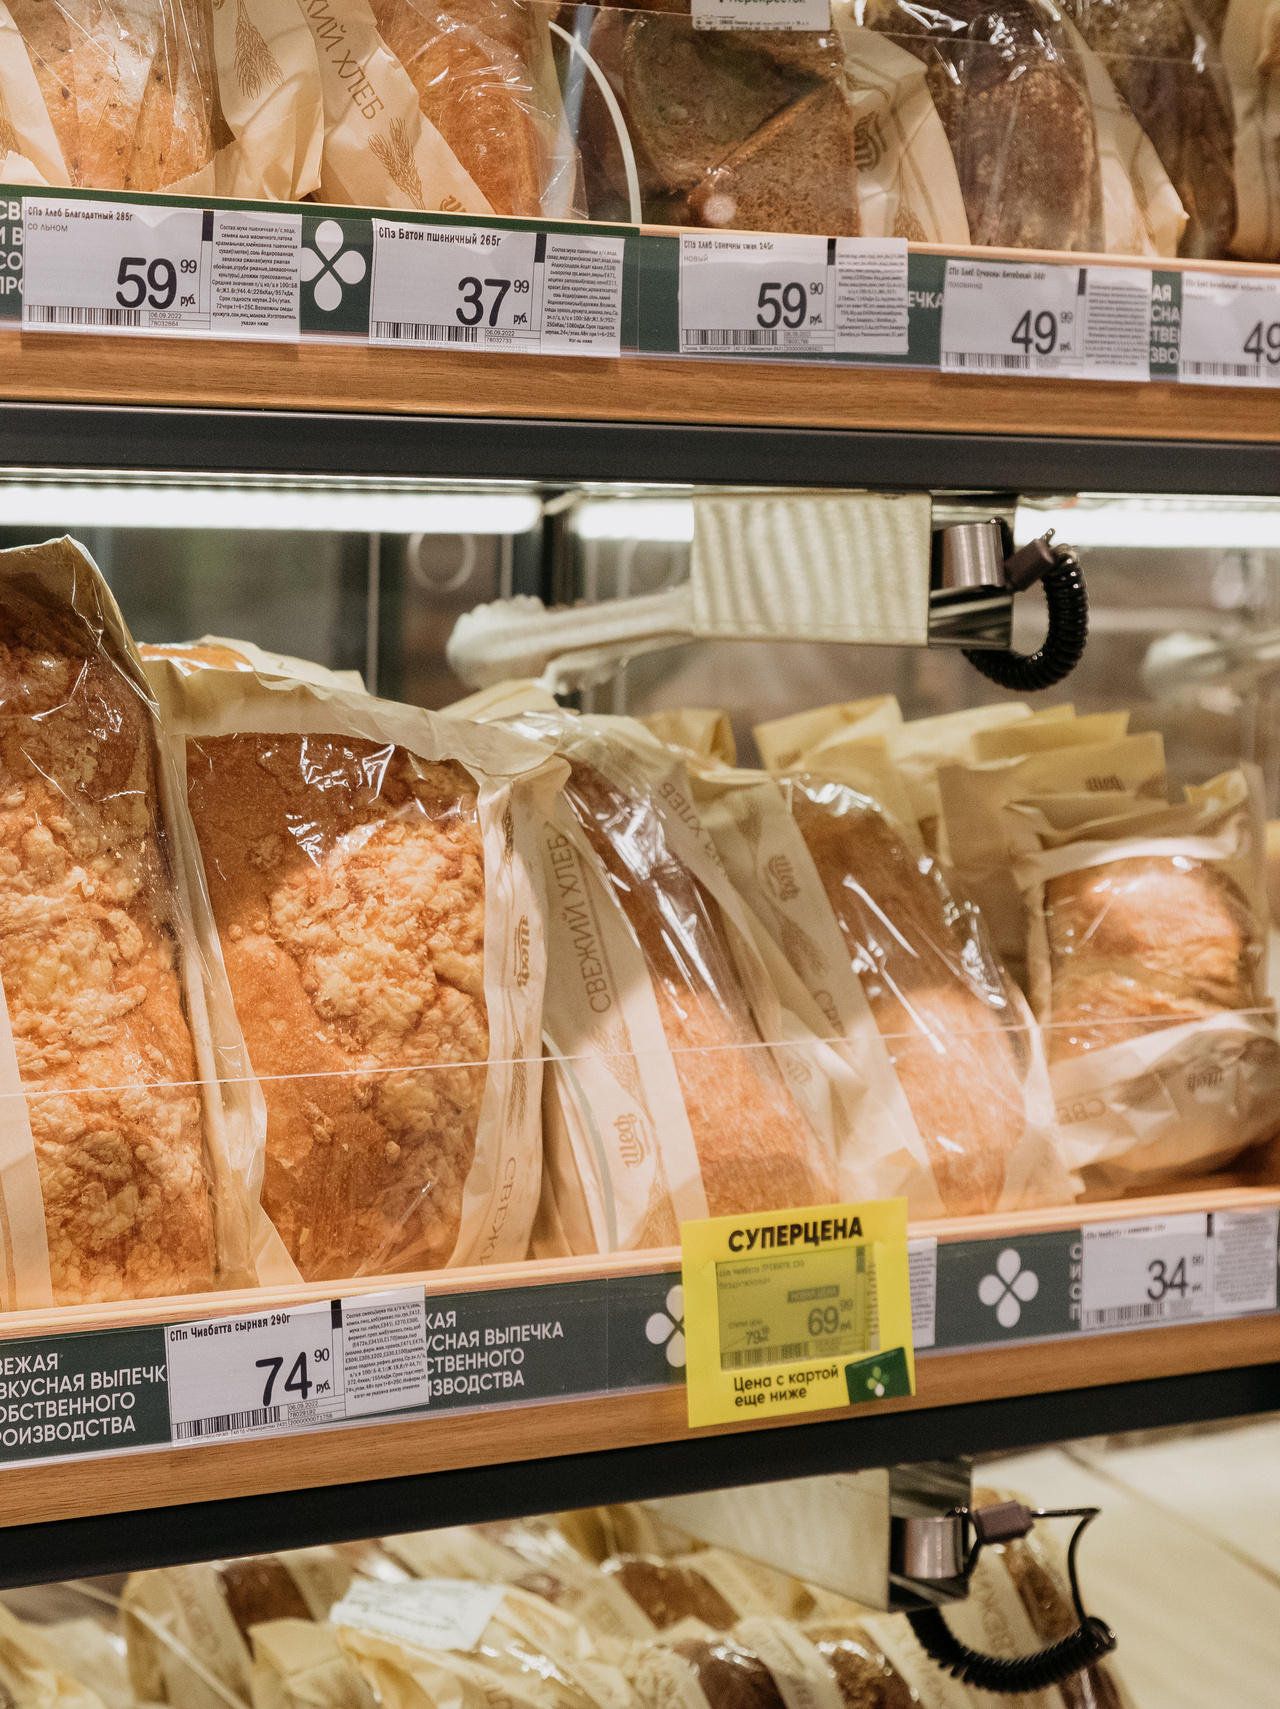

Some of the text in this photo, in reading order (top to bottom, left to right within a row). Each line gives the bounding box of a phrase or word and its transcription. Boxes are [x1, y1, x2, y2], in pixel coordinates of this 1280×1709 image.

[332, 50, 385, 119] ХЛЕБ
[41, 223, 68, 232] льном
[45, 208, 62, 217] Хлеб
[65, 208, 114, 220] Благодатный
[116, 211, 133, 221] 285г
[379, 227, 501, 246] СПз Батон пшеничный 265г
[684, 253, 708, 262] новый
[115, 257, 177, 310] 59
[180, 259, 197, 274] 99
[180, 294, 196, 307] руб.
[456, 276, 530, 328] 37 99
[756, 282, 823, 329] 59 90
[513, 313, 528, 325] руб.
[1011, 309, 1058, 355] 49
[1150, 325, 1180, 343] ТВЕ
[1243, 322, 1280, 365] 49
[546, 830, 613, 1013] СВЕЖИЙ ХЛЕБ
[728, 1216, 863, 1252] СУПЕРЦЕНА
[1147, 1257, 1188, 1301] 34
[190, 1323, 232, 1339] Чиабатта
[235, 1319, 268, 1334] сырная
[270, 1313, 291, 1328] 290г
[485, 1321, 564, 1346] ВЫПЕЧКА
[807, 1305, 840, 1337] 69
[90, 1364, 168, 1389] ВЫПЕЧК
[255, 1348, 330, 1407] 74 90
[316, 1382, 331, 1394] руб.
[734, 1365, 839, 1392] Цена с картой
[735, 1387, 807, 1407] еще ниже
